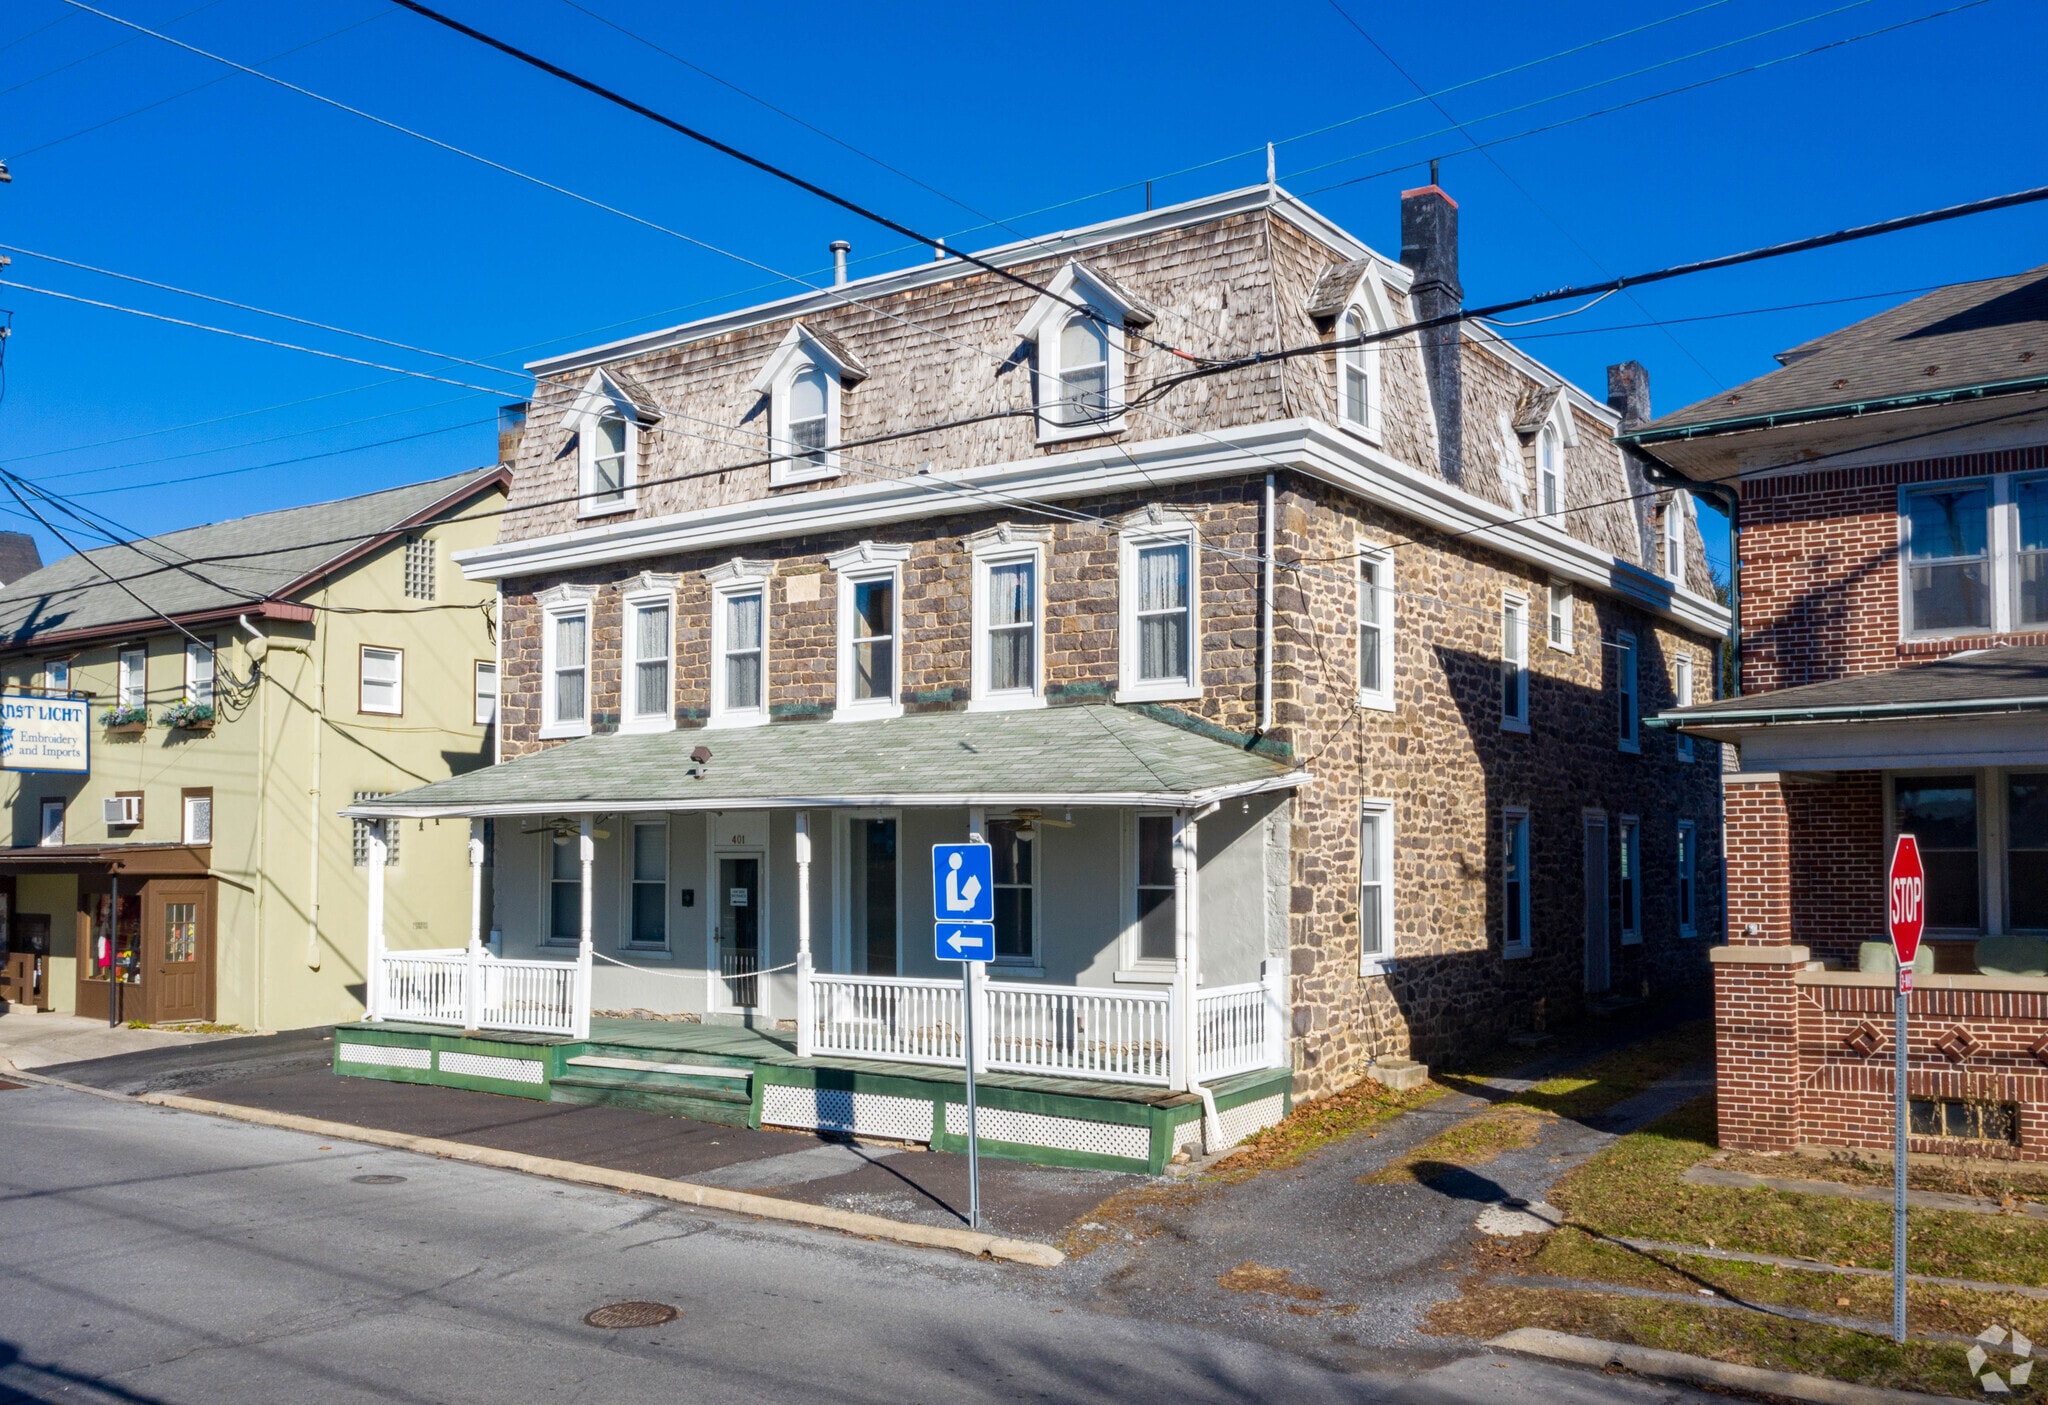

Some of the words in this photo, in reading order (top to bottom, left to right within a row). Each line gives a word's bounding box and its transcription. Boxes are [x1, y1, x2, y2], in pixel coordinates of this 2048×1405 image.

[39, 706, 83, 722] LICHT
[20, 731, 78, 747] Embroidery
[19, 745, 38, 756] and
[42, 745, 81, 759] Imports
[731, 834, 745, 845] 401
[1892, 876, 1921, 925] STOP
